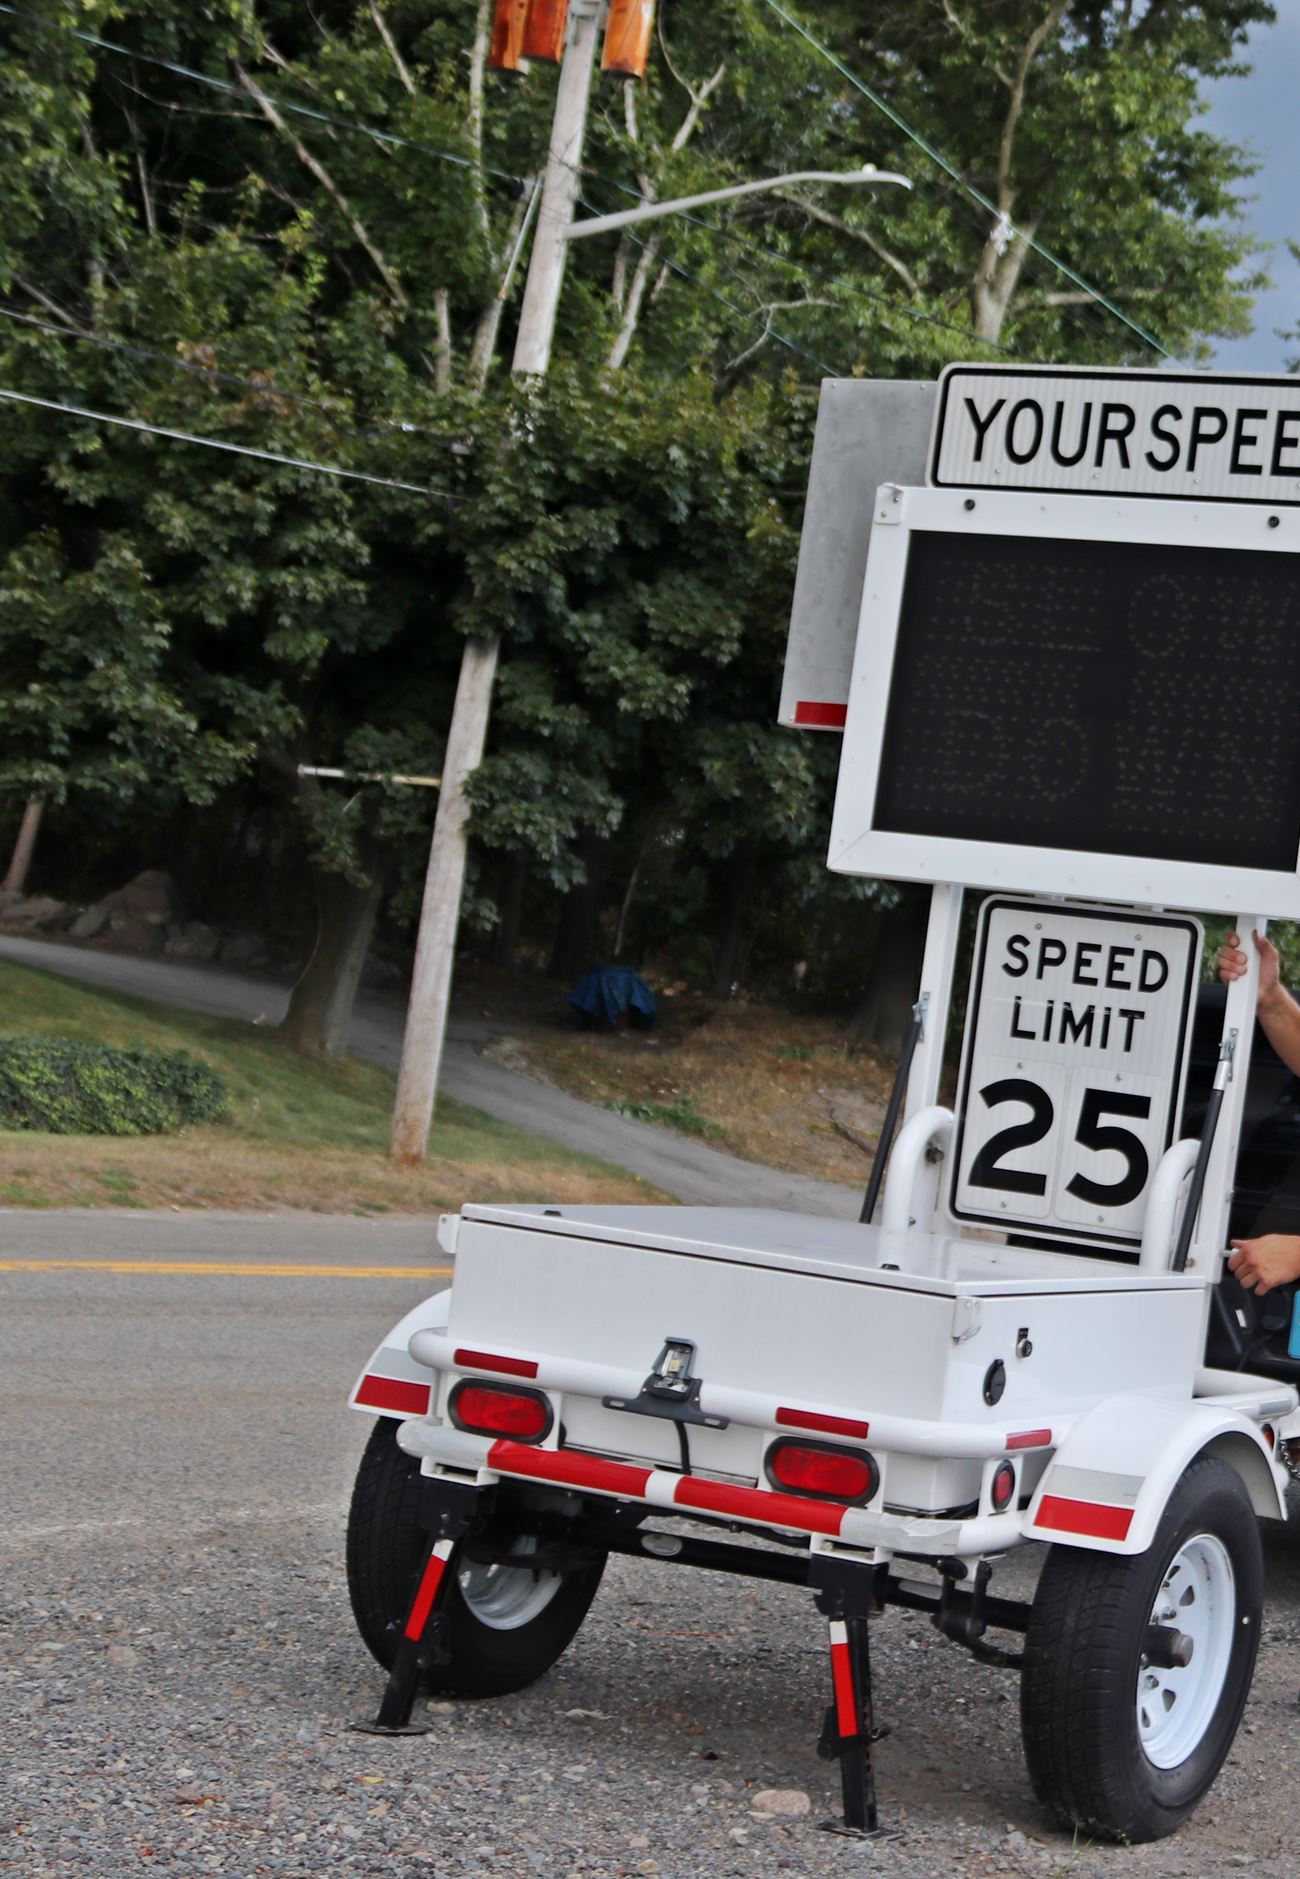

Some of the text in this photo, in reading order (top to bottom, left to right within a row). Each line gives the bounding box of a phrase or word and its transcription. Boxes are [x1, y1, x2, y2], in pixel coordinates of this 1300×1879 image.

[964, 397, 1136, 469] YOUR
[1001, 933, 1169, 993] SPEED
[1009, 996, 1146, 1052] LIMIT
[967, 1078, 1152, 1207] 25
